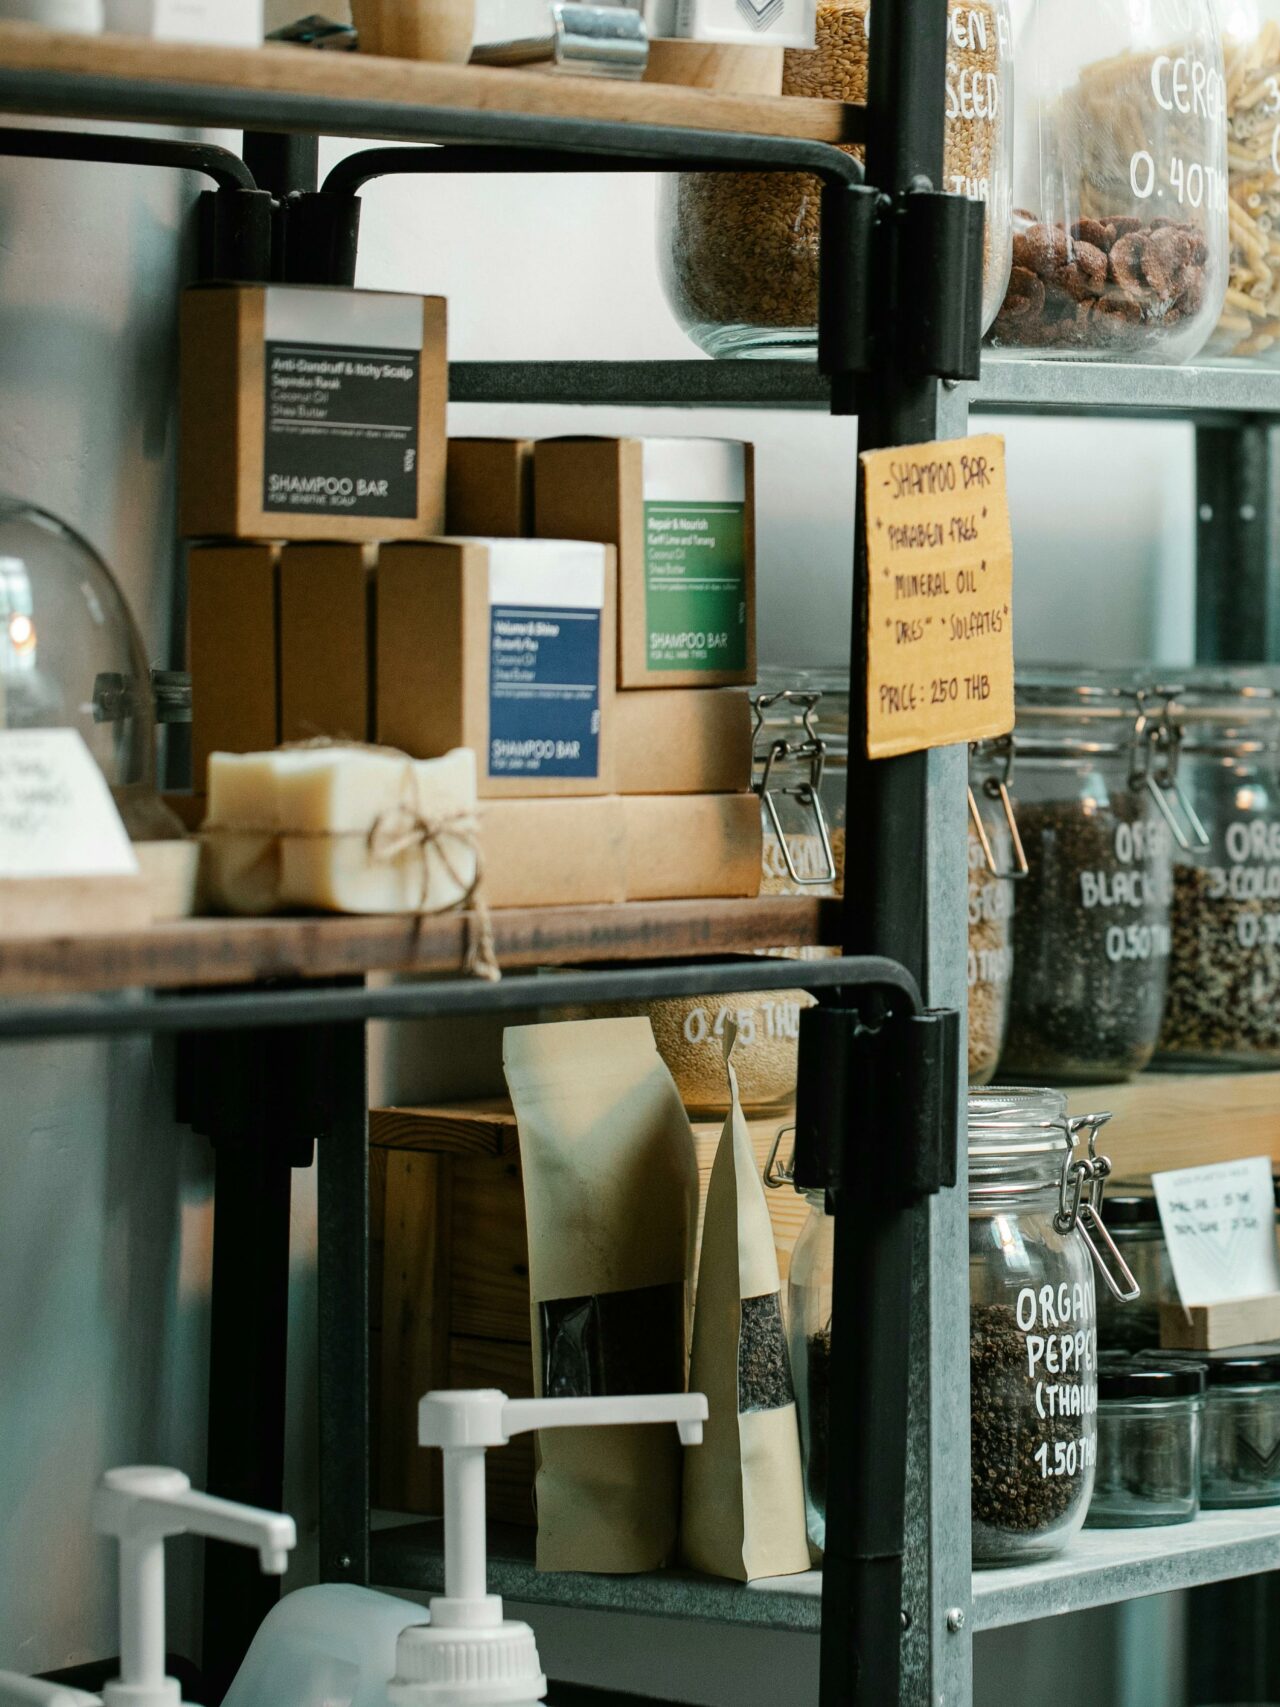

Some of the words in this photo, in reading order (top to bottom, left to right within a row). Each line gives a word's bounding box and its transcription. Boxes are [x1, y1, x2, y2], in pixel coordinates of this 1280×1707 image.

[269, 474, 353, 496] SHAMPOO
[356, 478, 389, 497] BAR
[650, 632, 706, 649] SHAMPOO
[707, 632, 728, 648] BAR
[931, 677, 958, 704] 250
[964, 674, 991, 701] THB
[491, 738, 555, 760] SHAMPOO
[556, 740, 580, 759] BAR
